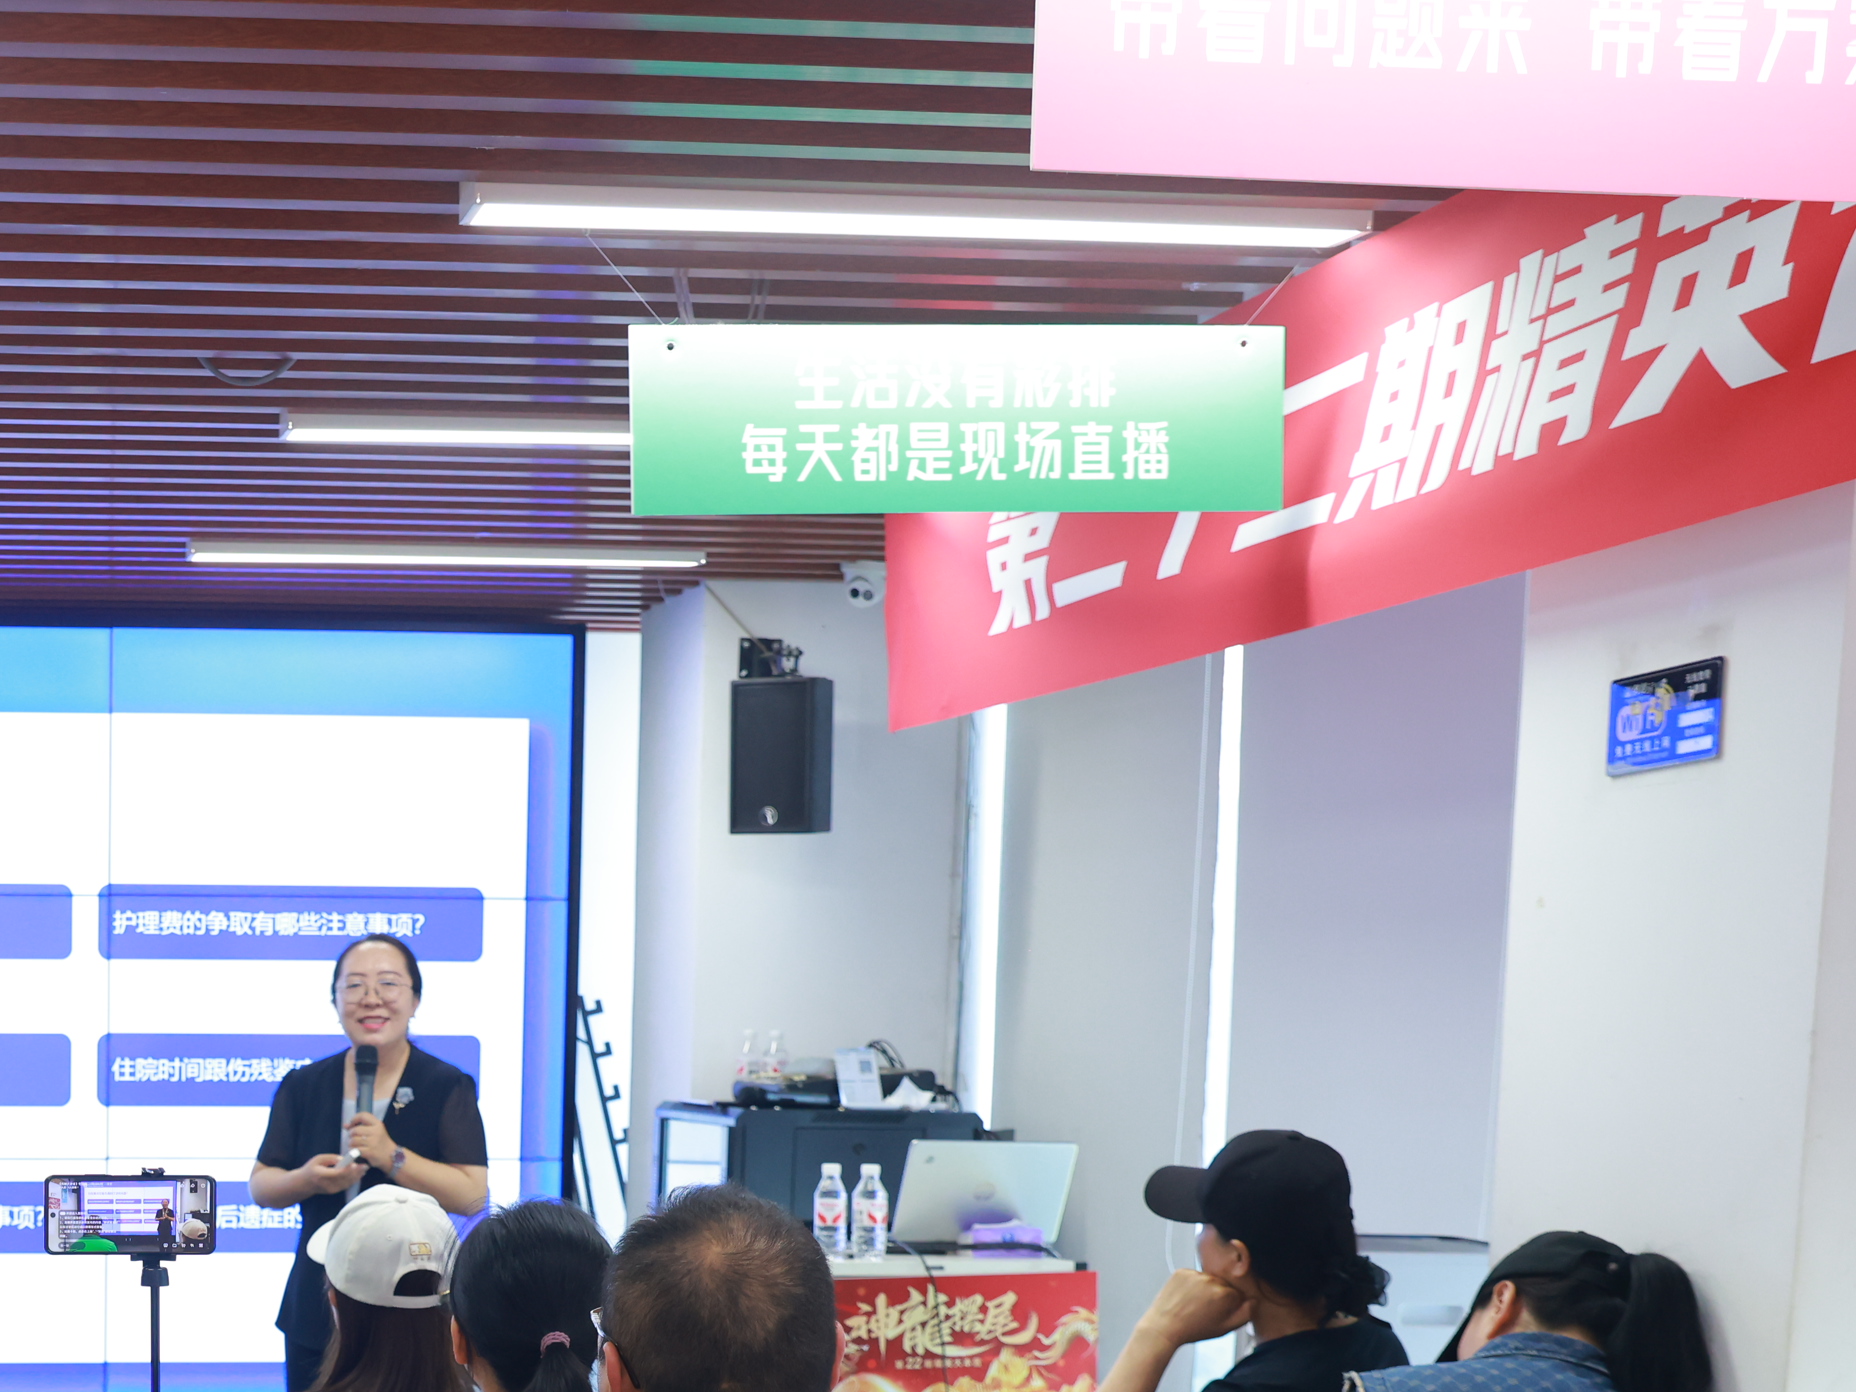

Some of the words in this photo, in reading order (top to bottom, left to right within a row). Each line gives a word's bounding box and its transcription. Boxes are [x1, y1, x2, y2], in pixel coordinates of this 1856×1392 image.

[1589, 0, 1856, 85] 带着方
[741, 421, 1170, 482] 每天都是现场直播
[986, 195, 1856, 636] 第二期精英
[112, 910, 426, 938] 护理费的争取有哪些注意事项？
